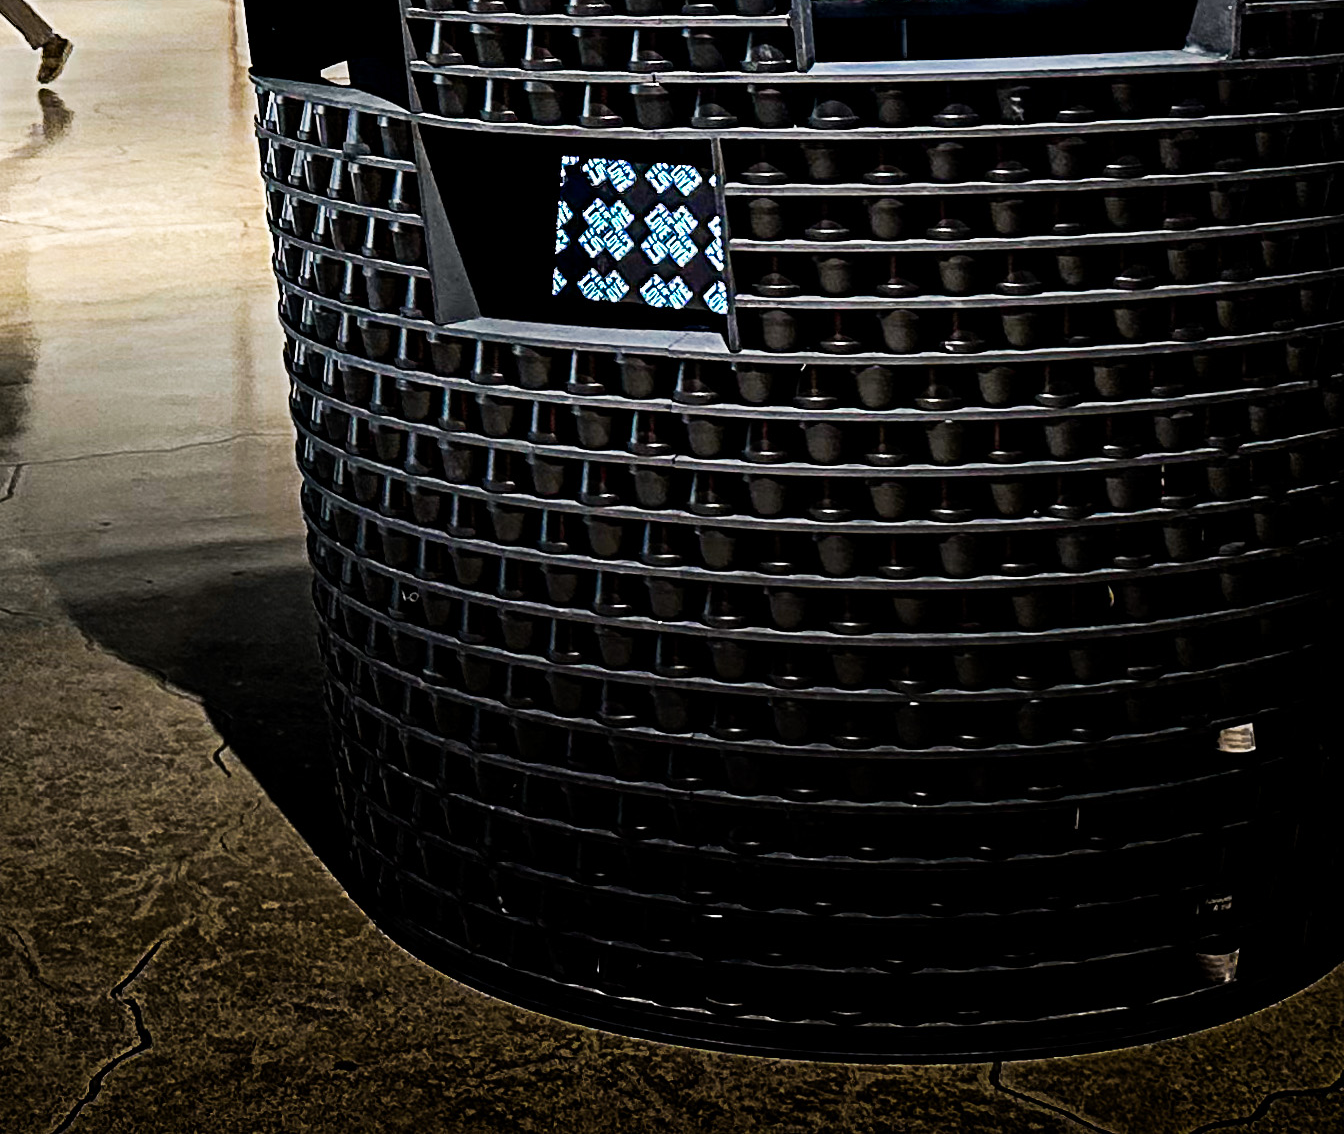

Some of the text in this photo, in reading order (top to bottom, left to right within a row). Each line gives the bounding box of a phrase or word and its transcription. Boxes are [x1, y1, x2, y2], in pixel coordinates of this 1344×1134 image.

[582, 204, 610, 235] LOVE
[644, 210, 673, 241] LOVE
[603, 230, 630, 262] LOVE
[666, 235, 693, 268] LOVE
